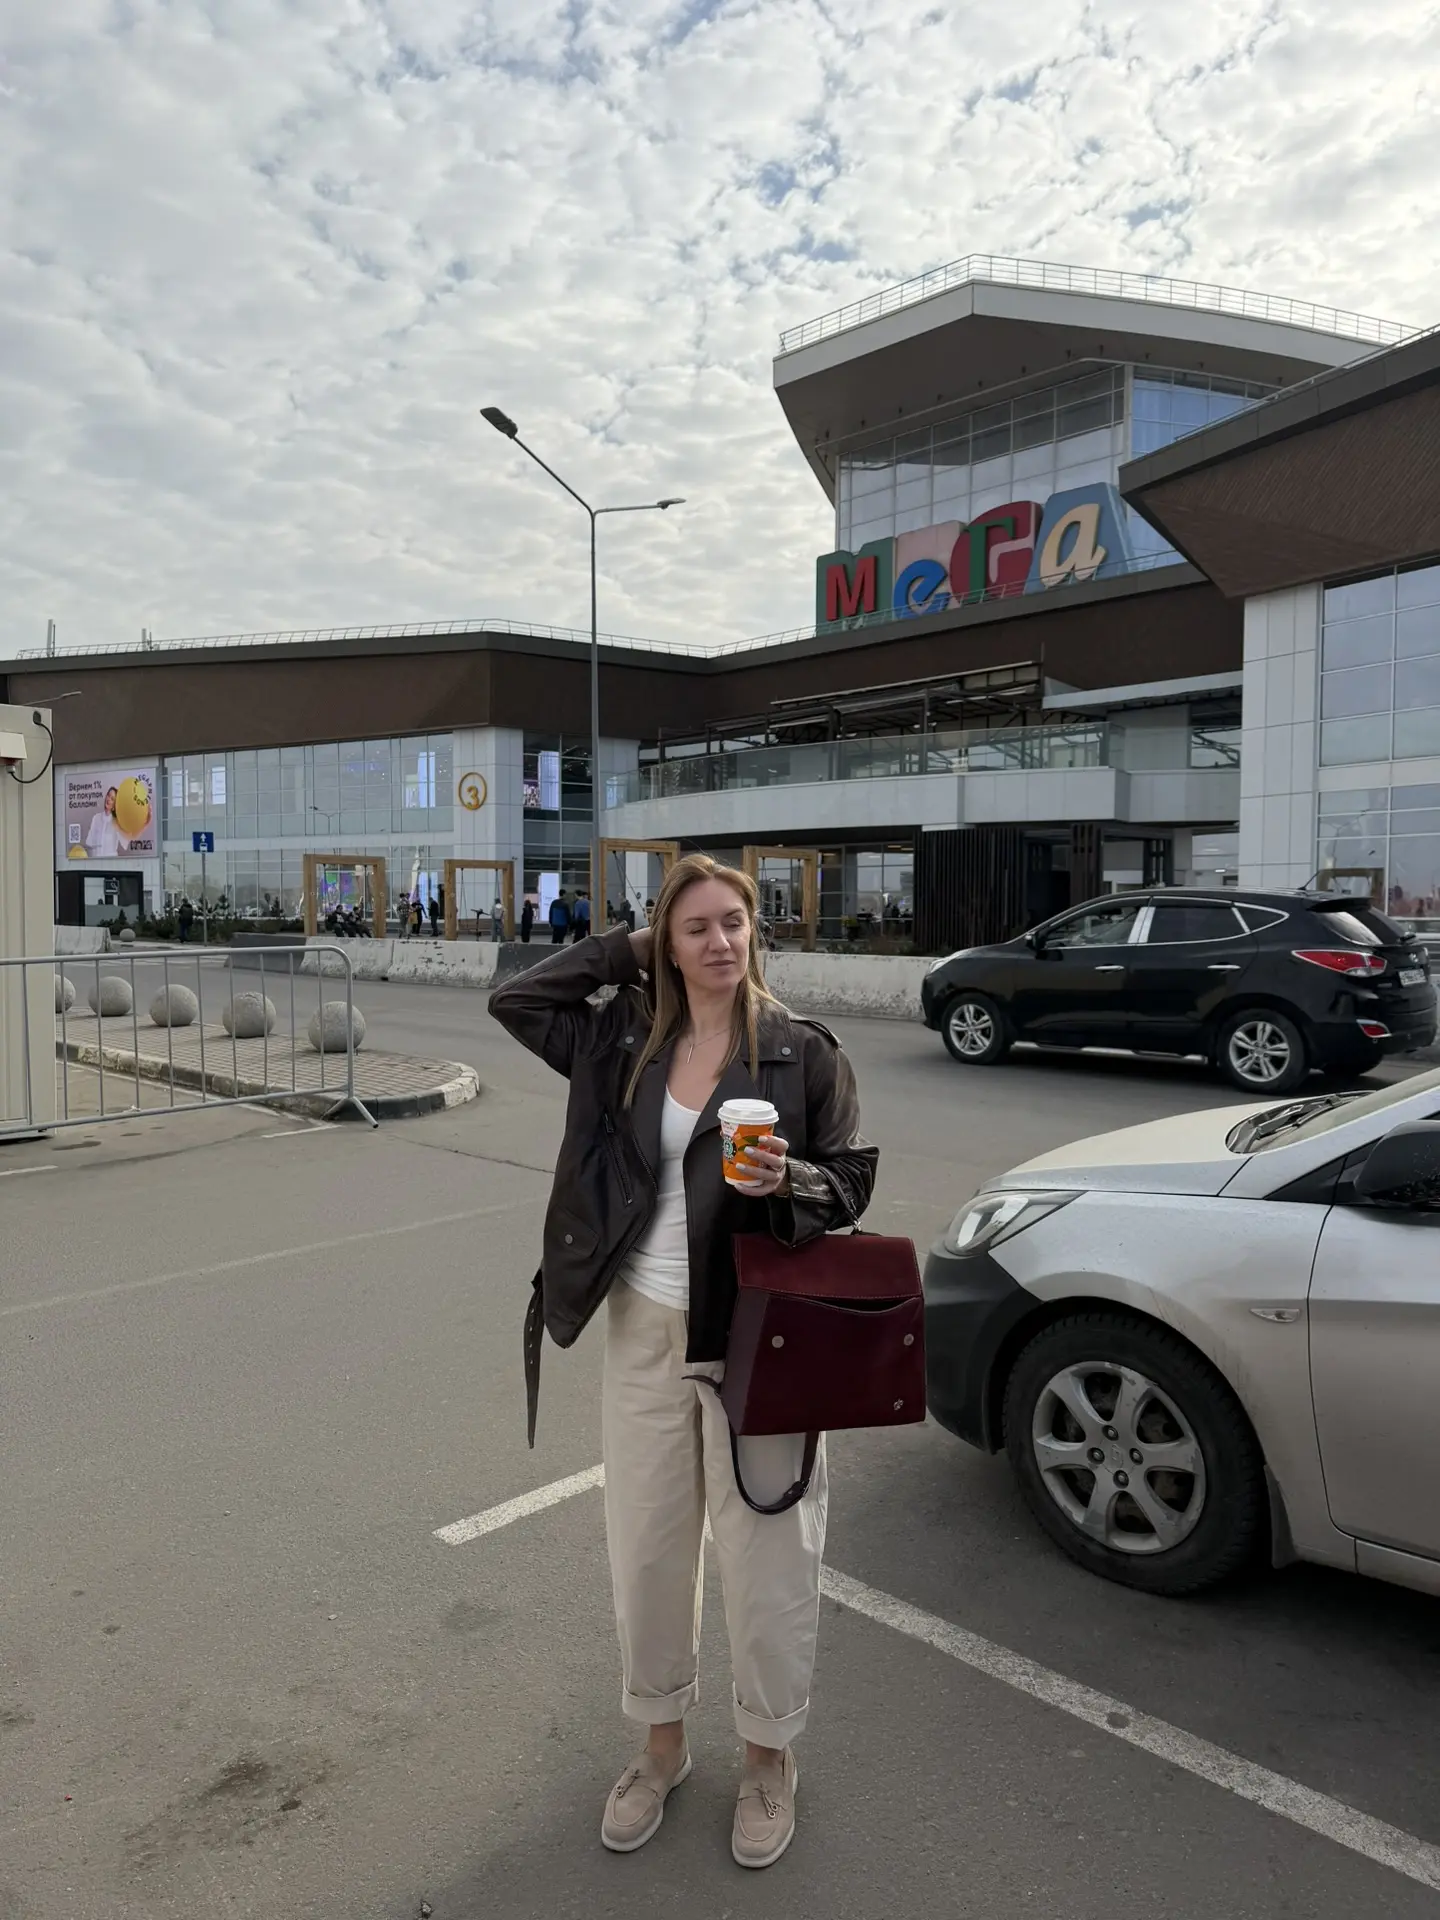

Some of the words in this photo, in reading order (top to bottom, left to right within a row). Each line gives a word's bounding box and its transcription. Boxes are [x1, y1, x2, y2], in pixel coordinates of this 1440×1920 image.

[94, 781, 102, 789] 1%
[76, 792, 103, 801] покупок
[465, 785, 480, 810] 3
[69, 801, 97, 809] баллами
